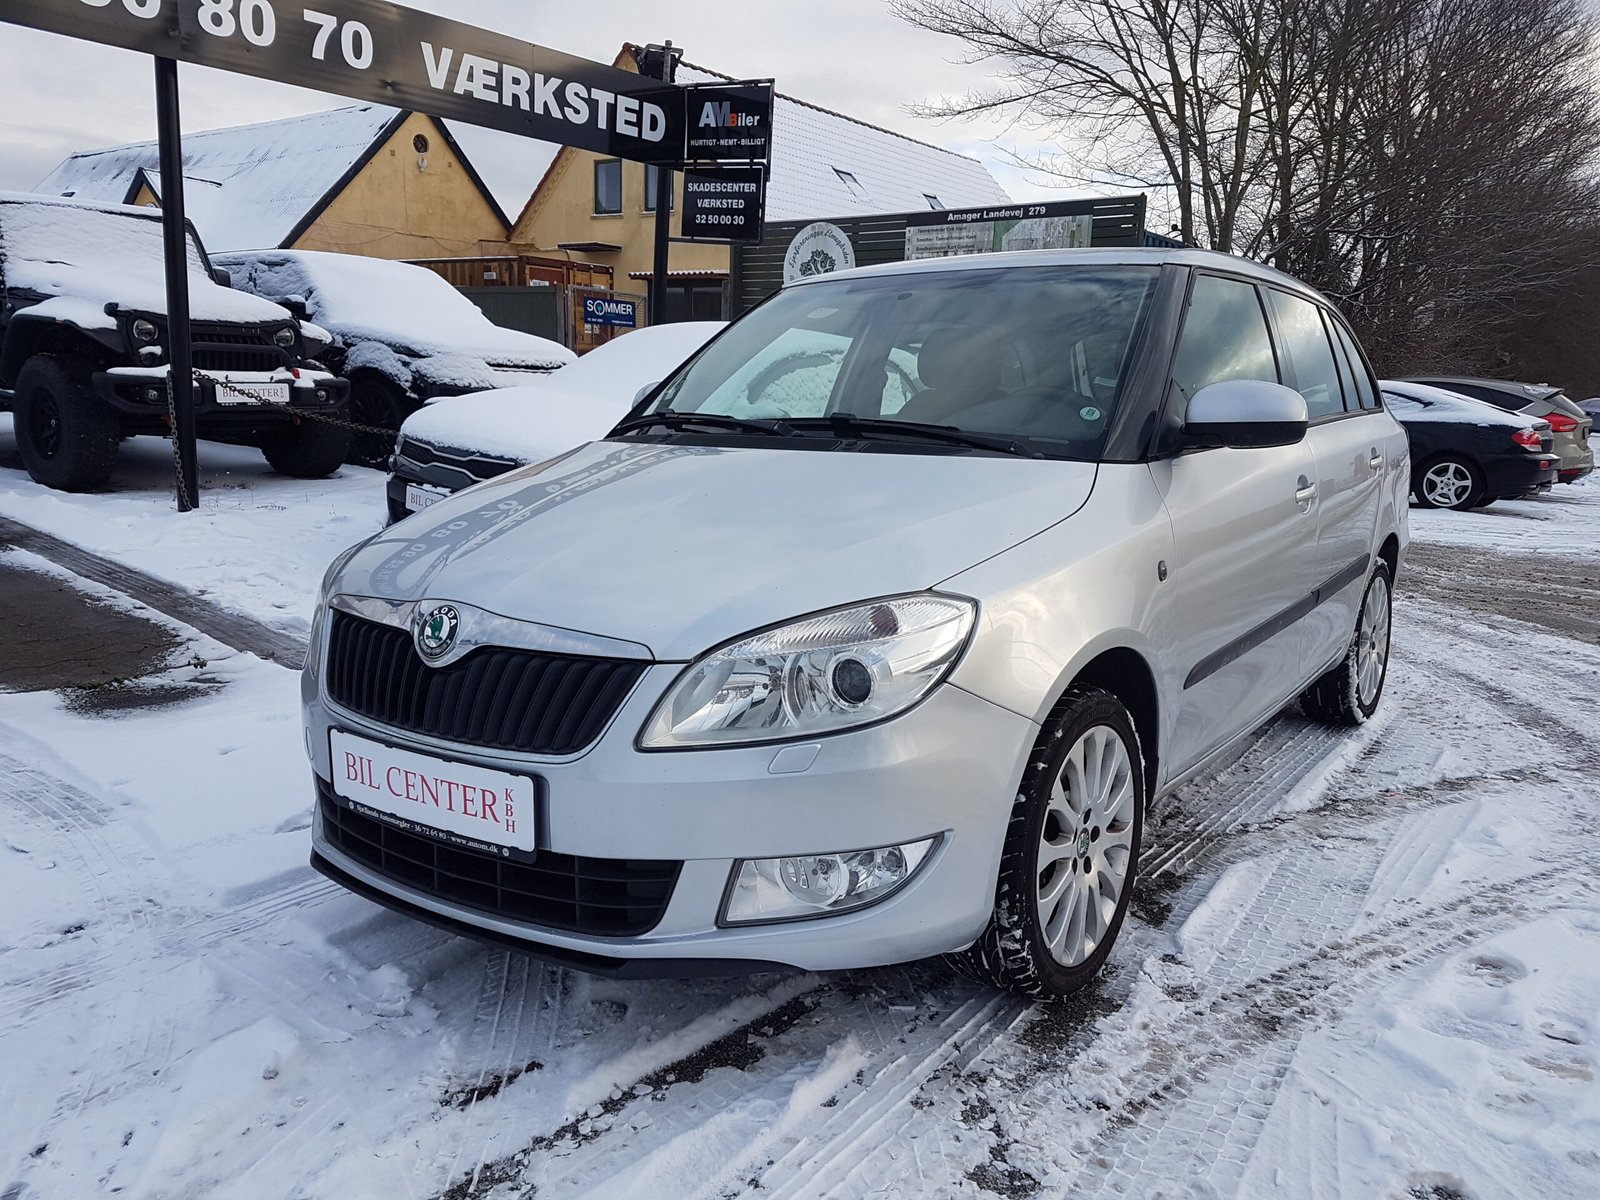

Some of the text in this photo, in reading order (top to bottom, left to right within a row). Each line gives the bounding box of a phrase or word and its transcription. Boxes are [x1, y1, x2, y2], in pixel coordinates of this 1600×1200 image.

[198, 0, 666, 143] 80 70 VÆRKSTED
[698, 101, 760, 128] AMBiler
[687, 182, 757, 193] SKADESCENTER
[696, 199, 745, 209] VÆRKSTED
[695, 214, 745, 225] 32 50 00 30
[947, 206, 1046, 221] Amager Landevej 279
[586, 300, 633, 315] SOMMER
[410, 492, 424, 506] BIL
[343, 751, 501, 823] BIL CENTER
[450, 836, 499, 853] www.autom.dk
